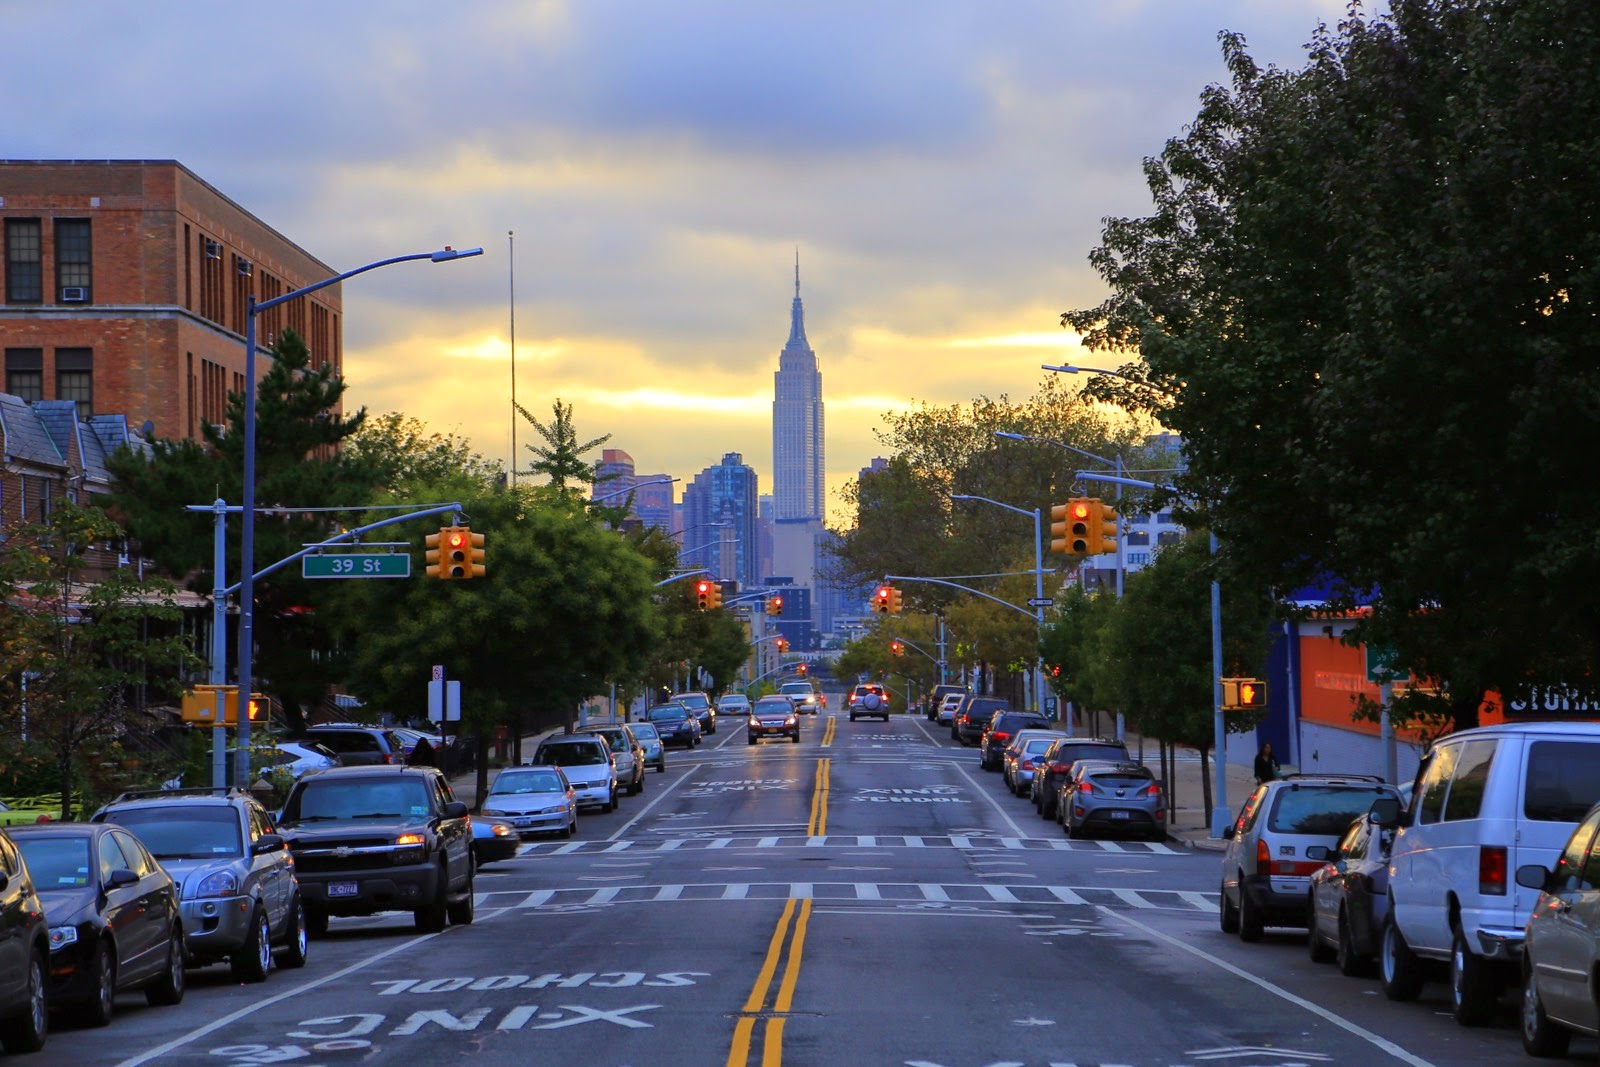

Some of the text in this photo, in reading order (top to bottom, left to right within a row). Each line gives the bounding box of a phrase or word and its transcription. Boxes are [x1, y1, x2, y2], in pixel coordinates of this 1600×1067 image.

[331, 559, 381, 573] 39 St
[370, 971, 711, 996] SCHOOL
